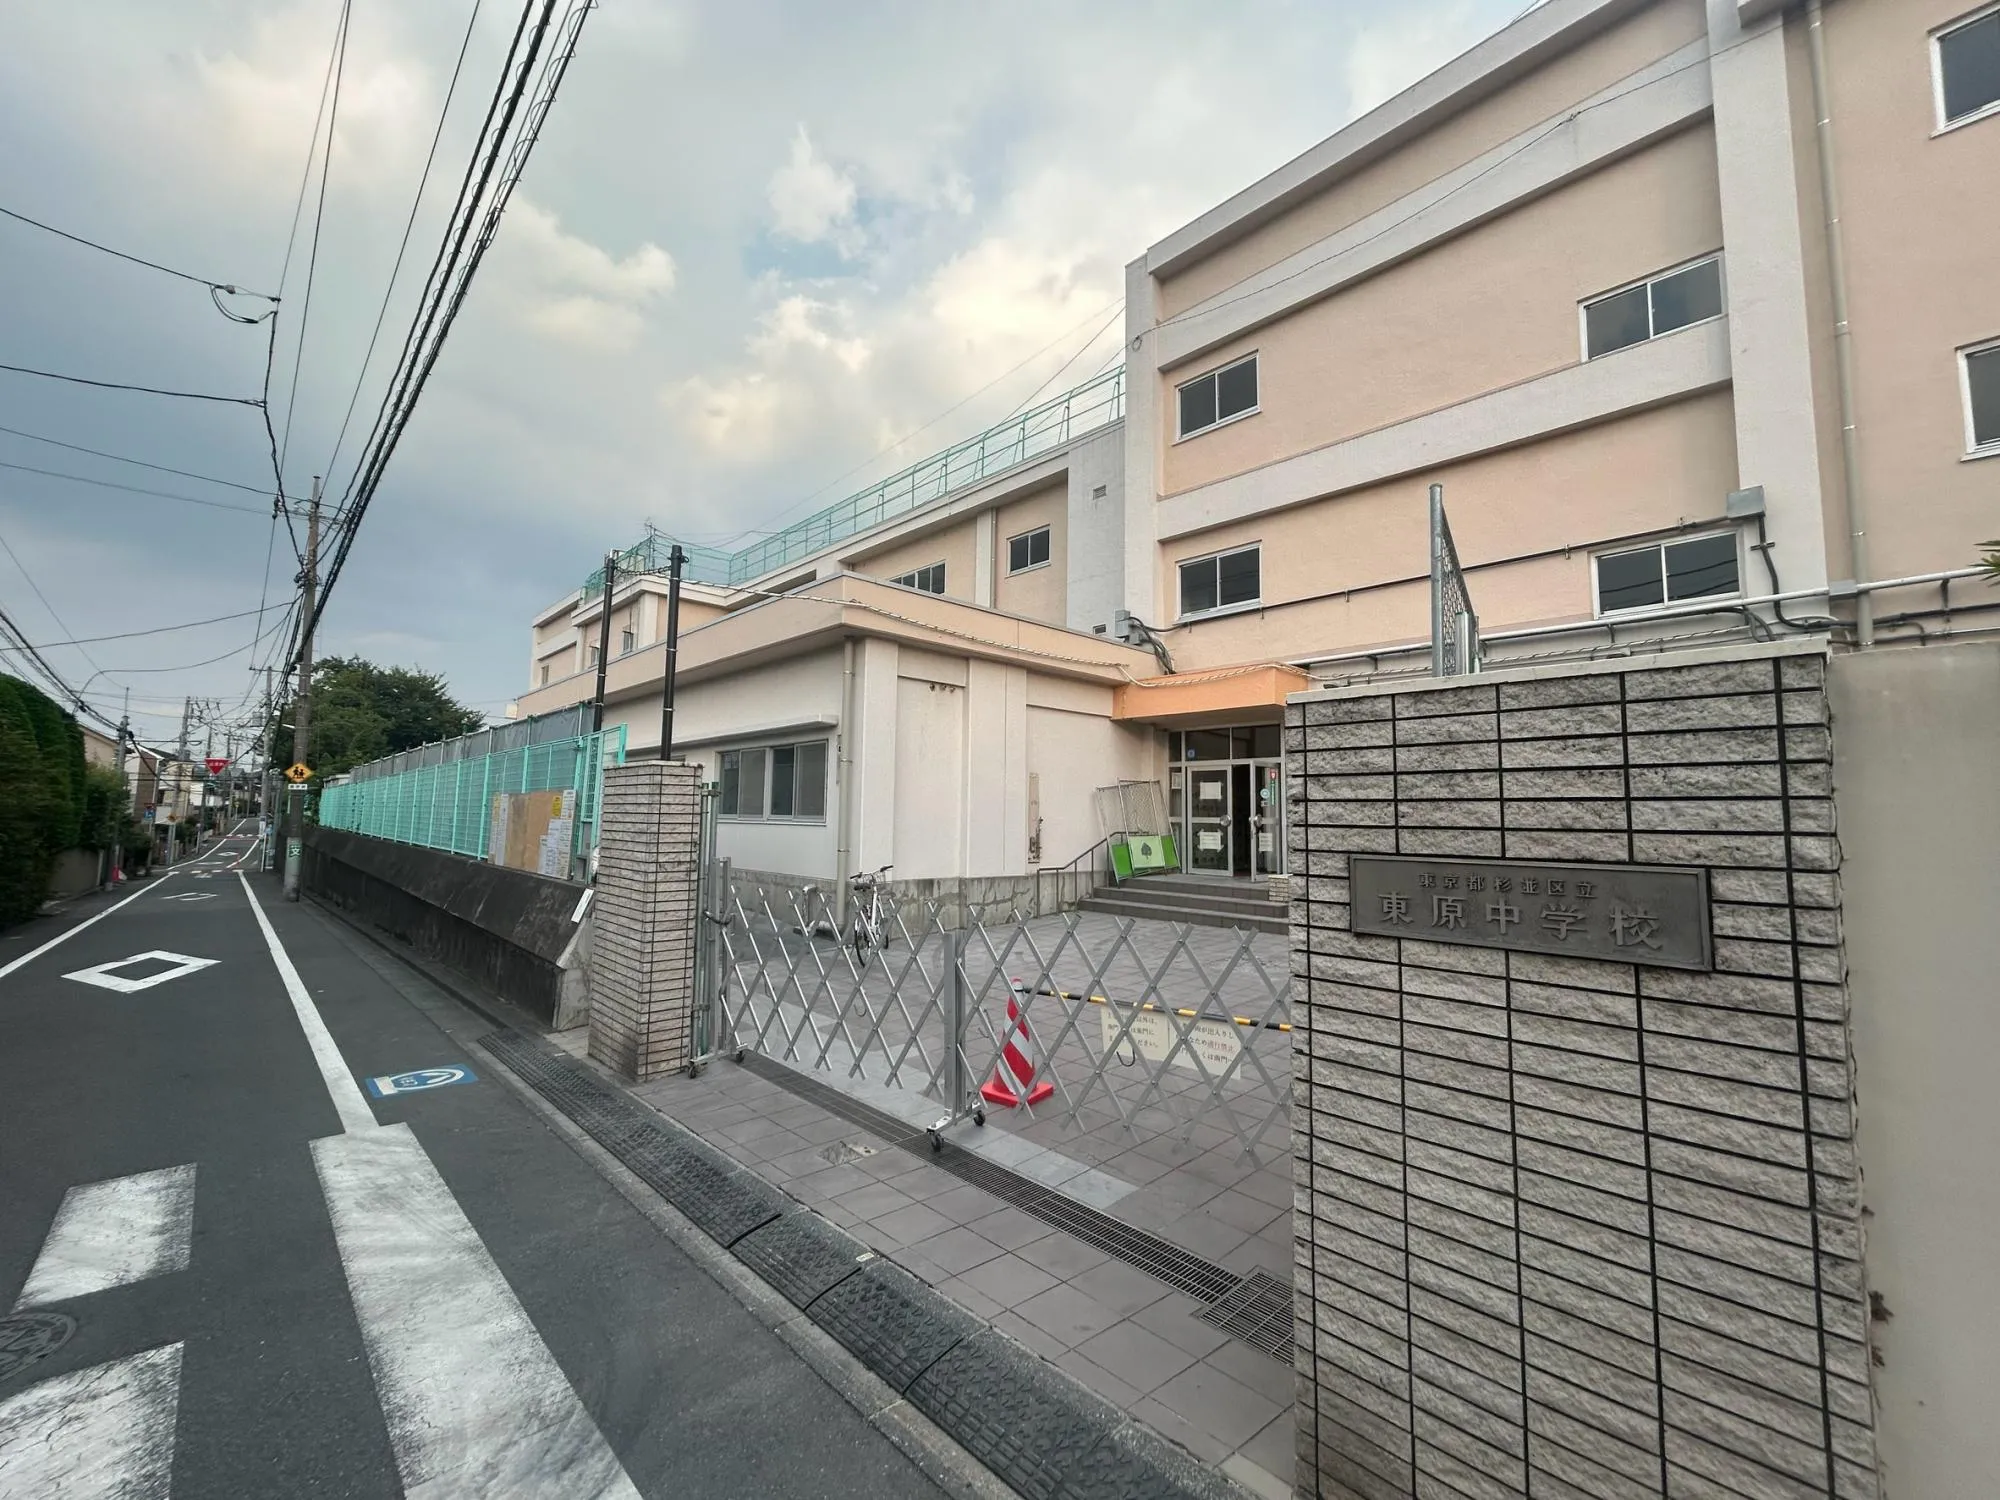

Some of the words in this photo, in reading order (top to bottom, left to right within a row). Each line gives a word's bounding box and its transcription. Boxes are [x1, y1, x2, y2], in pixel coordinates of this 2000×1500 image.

[1418, 872, 1597, 899] 東京都杉並区立
[1376, 891, 1664, 950] 東原中学校
